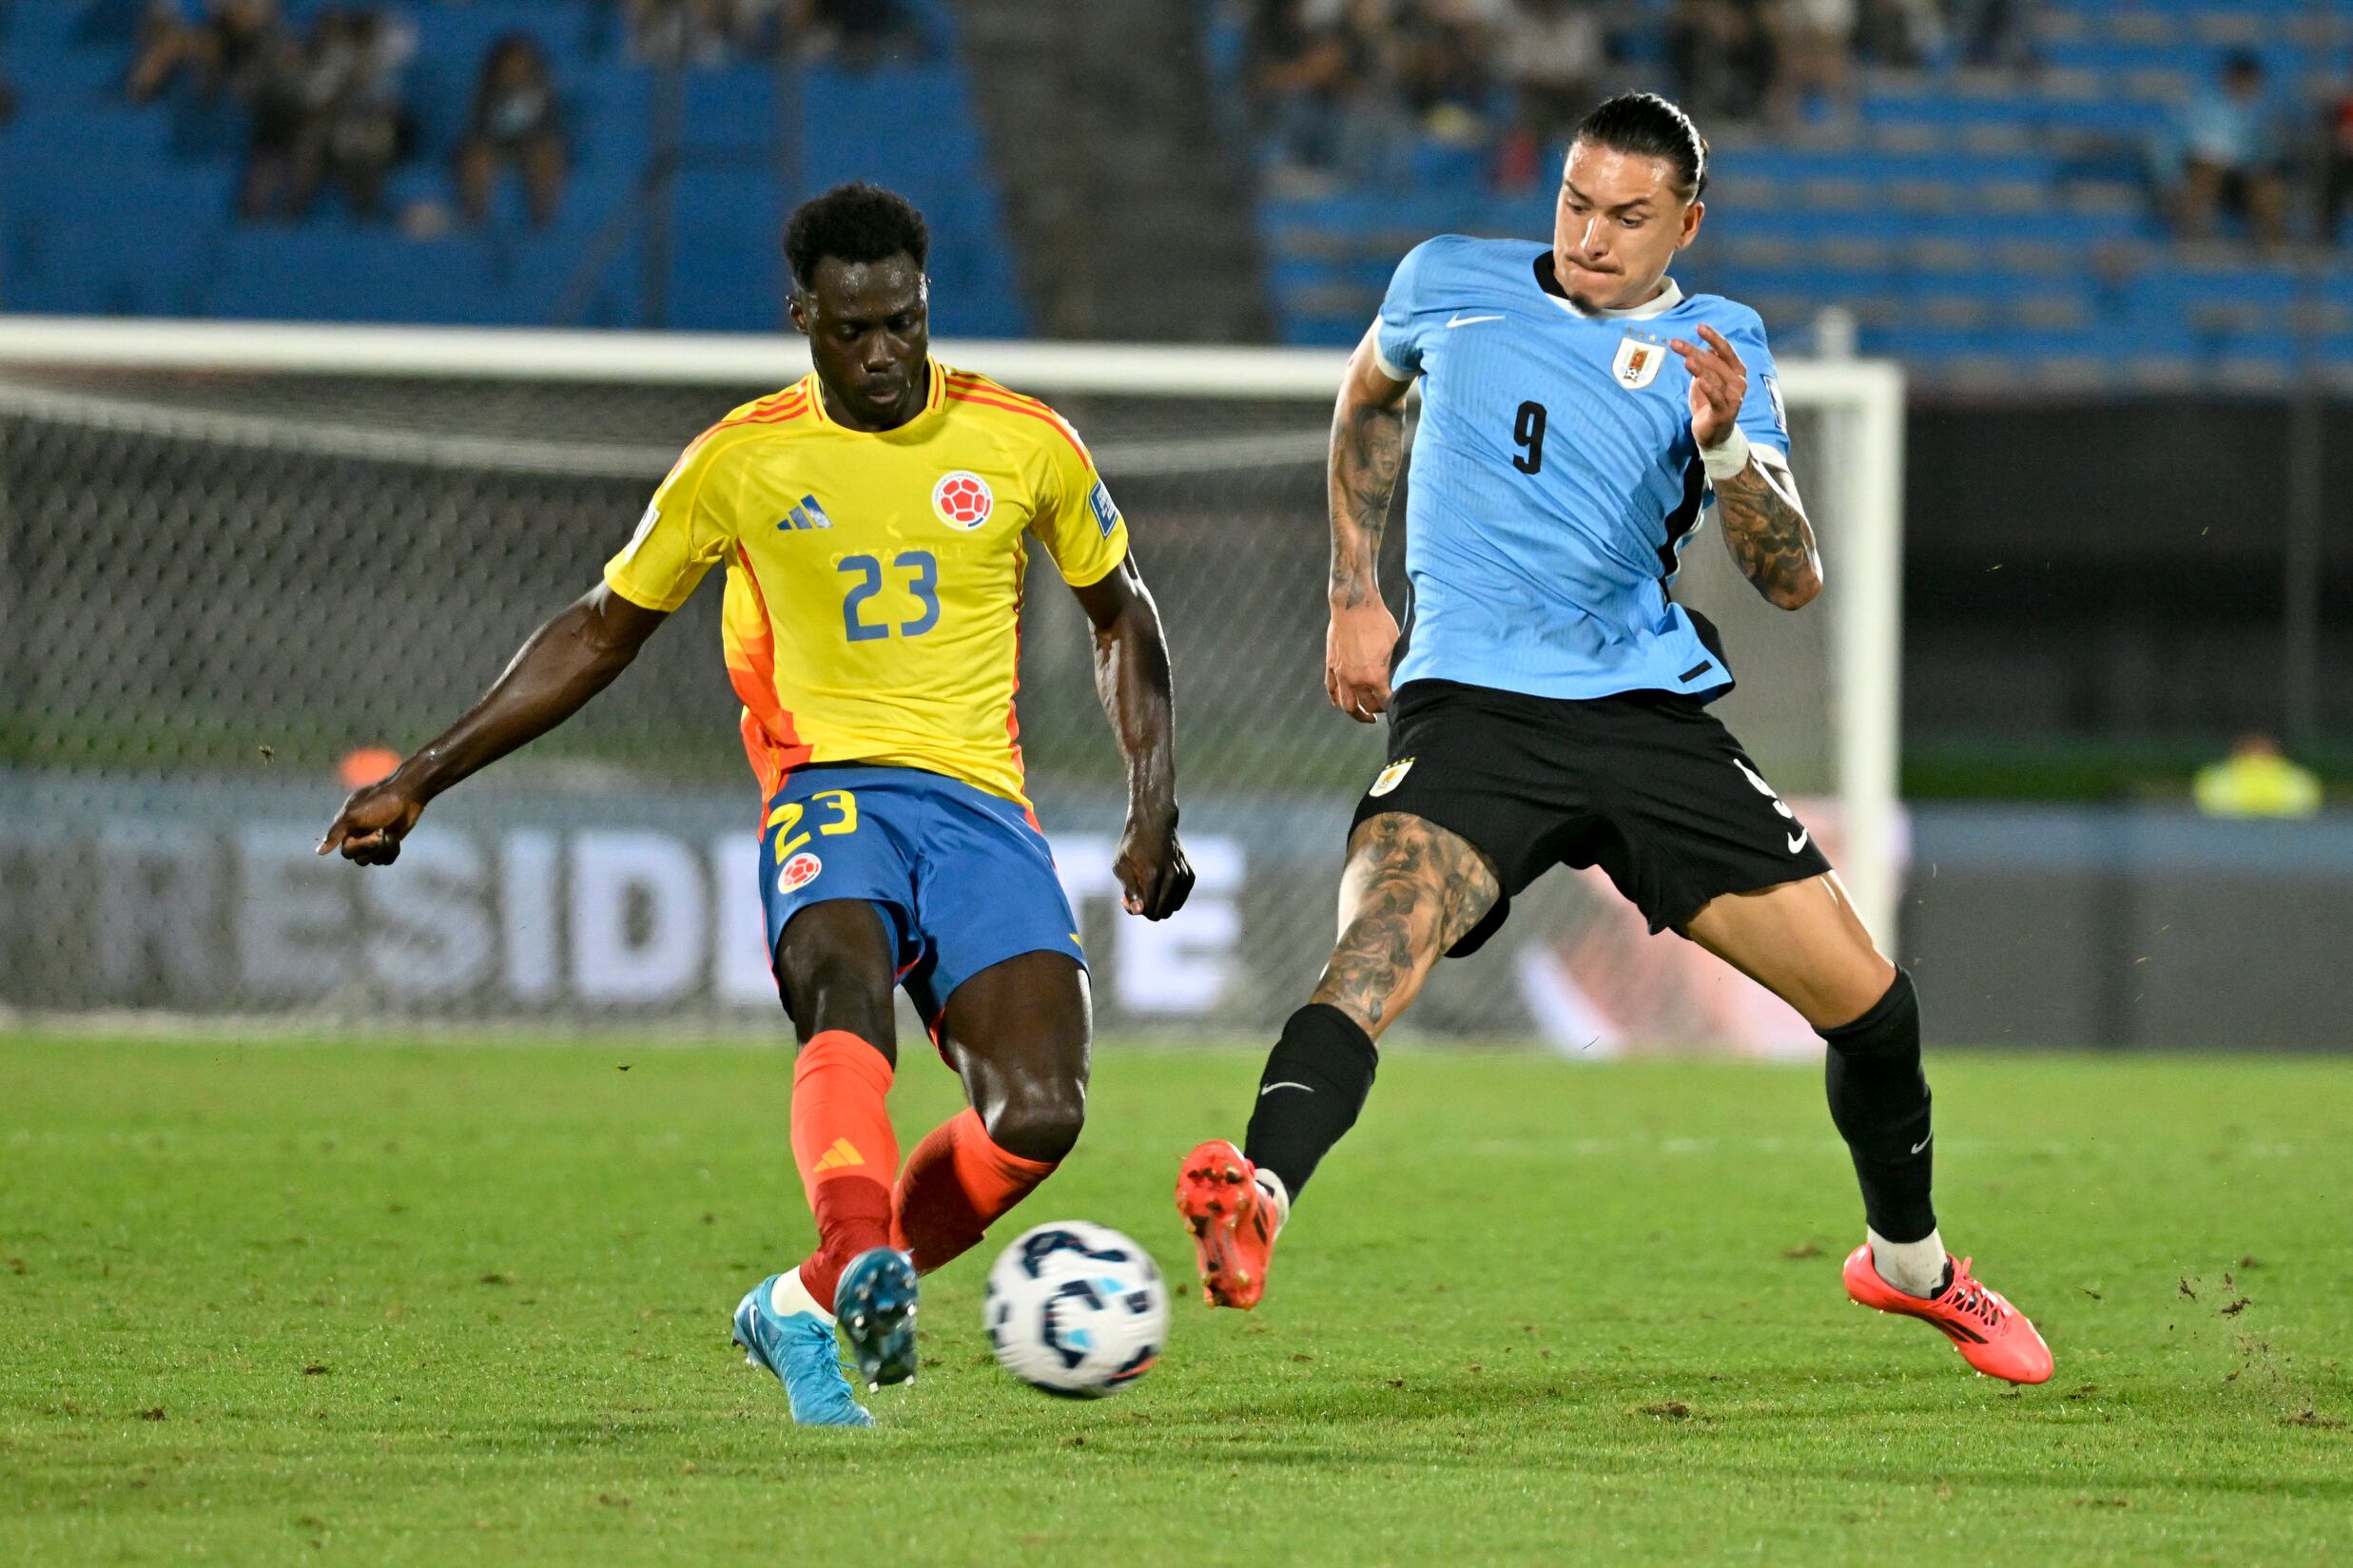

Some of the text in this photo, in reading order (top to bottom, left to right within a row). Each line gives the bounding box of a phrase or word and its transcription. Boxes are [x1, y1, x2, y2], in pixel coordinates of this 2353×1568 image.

[1512, 399, 1547, 475] 9
[836, 550, 941, 643] 23
[766, 789, 858, 866] 23
